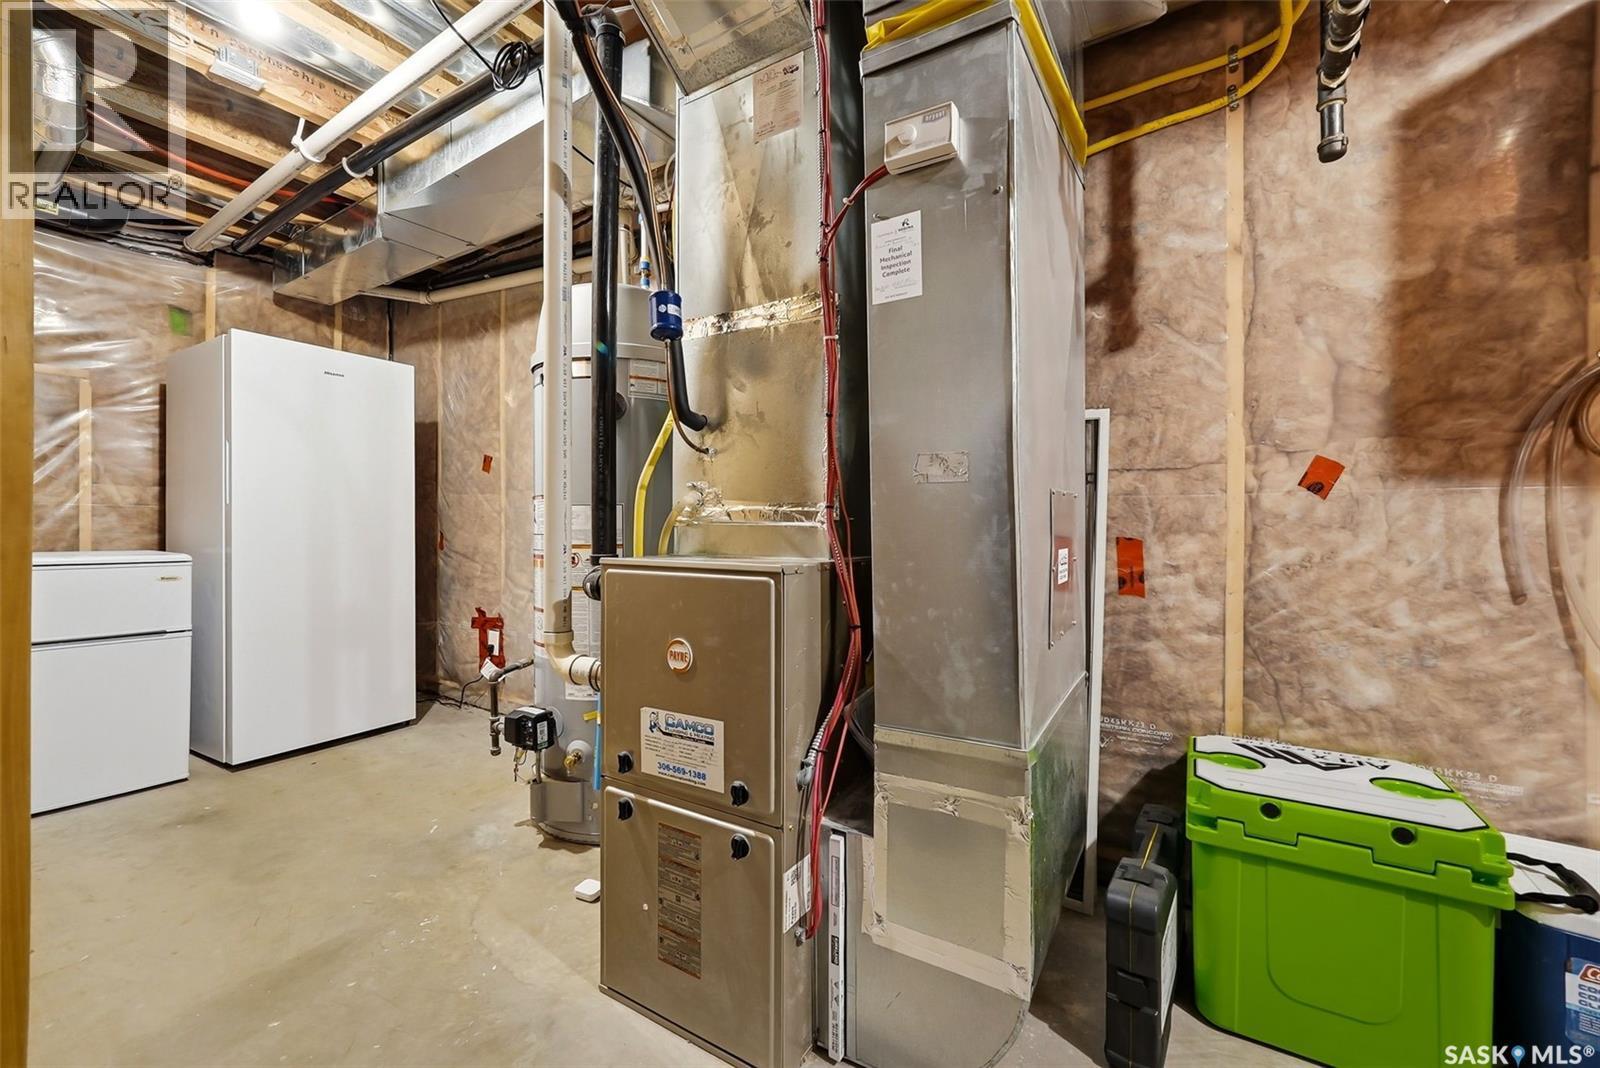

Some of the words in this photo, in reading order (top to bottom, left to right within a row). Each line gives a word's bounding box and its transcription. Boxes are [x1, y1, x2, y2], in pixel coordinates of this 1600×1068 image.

[888, 245, 903, 254] Final
[879, 250, 913, 263] Mechanical
[880, 259, 912, 271] Inspection
[881, 267, 911, 278] Complete
[669, 649, 689, 663] PAYNE
[664, 713, 715, 736] CAMCO
[657, 761, 707, 781] 306-569-1388
